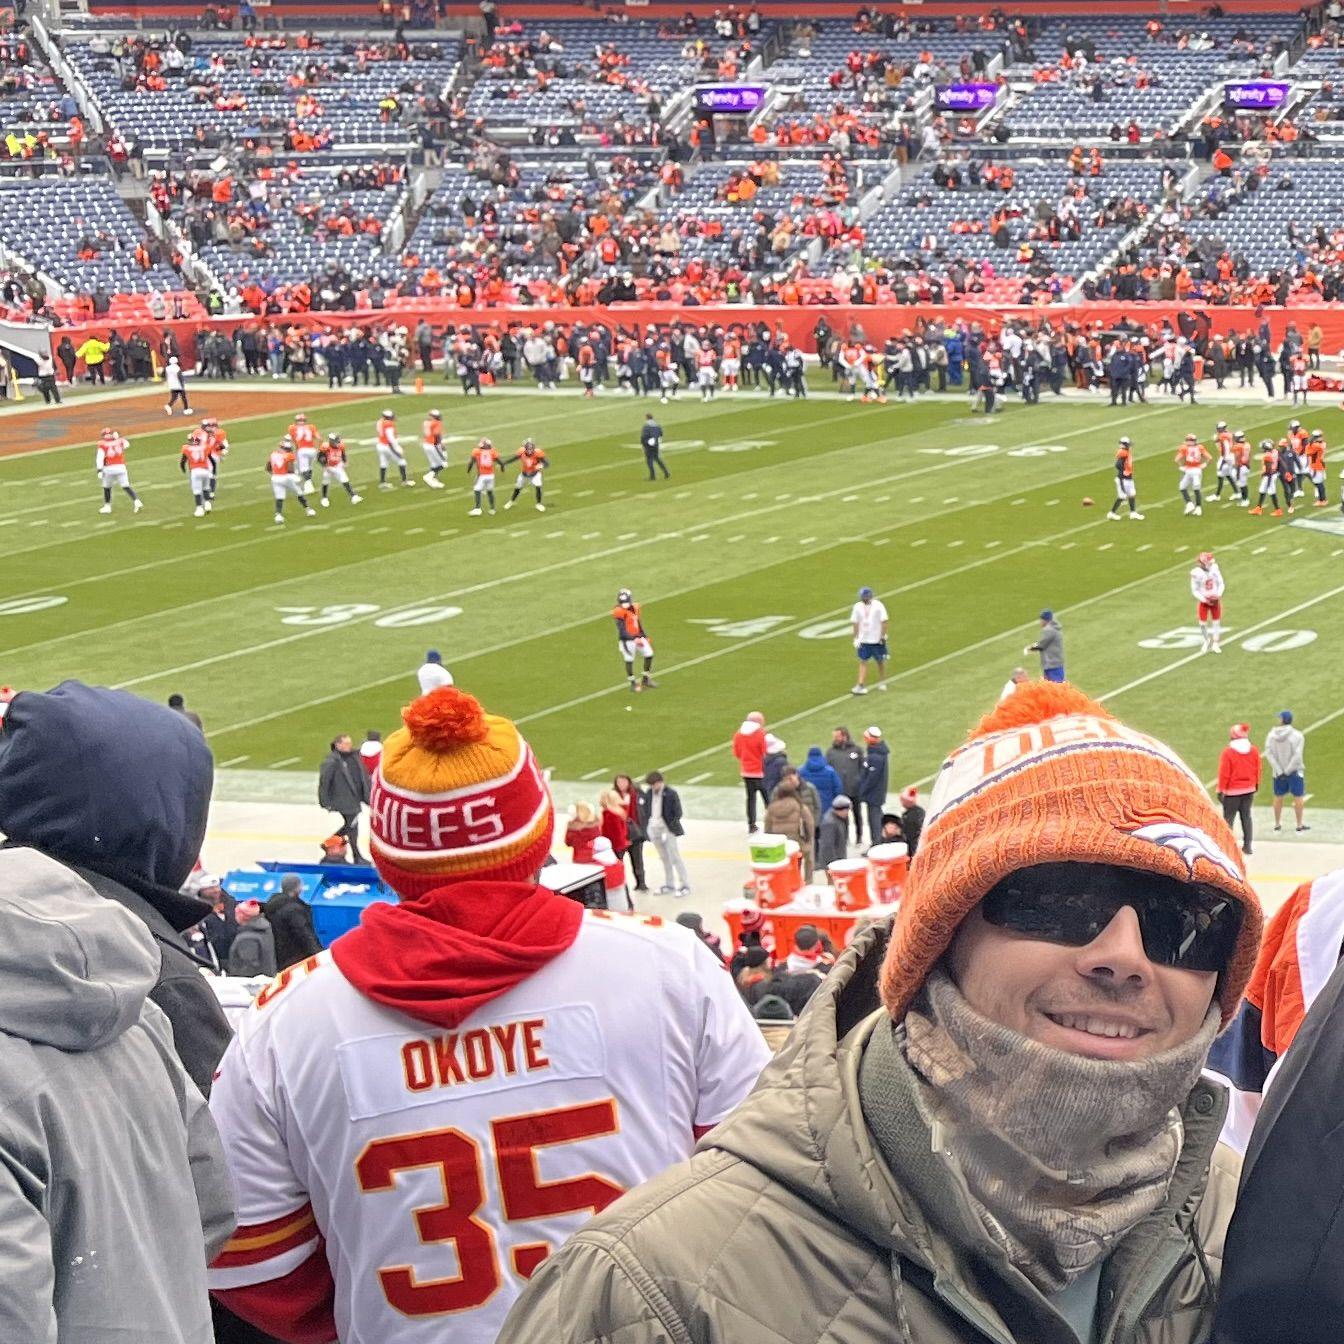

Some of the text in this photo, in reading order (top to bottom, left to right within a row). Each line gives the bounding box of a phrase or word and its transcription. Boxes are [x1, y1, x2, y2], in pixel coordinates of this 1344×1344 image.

[372, 787, 504, 848] HIEFS
[402, 1019, 550, 1093] OKOYE
[355, 1097, 628, 1319] 35
